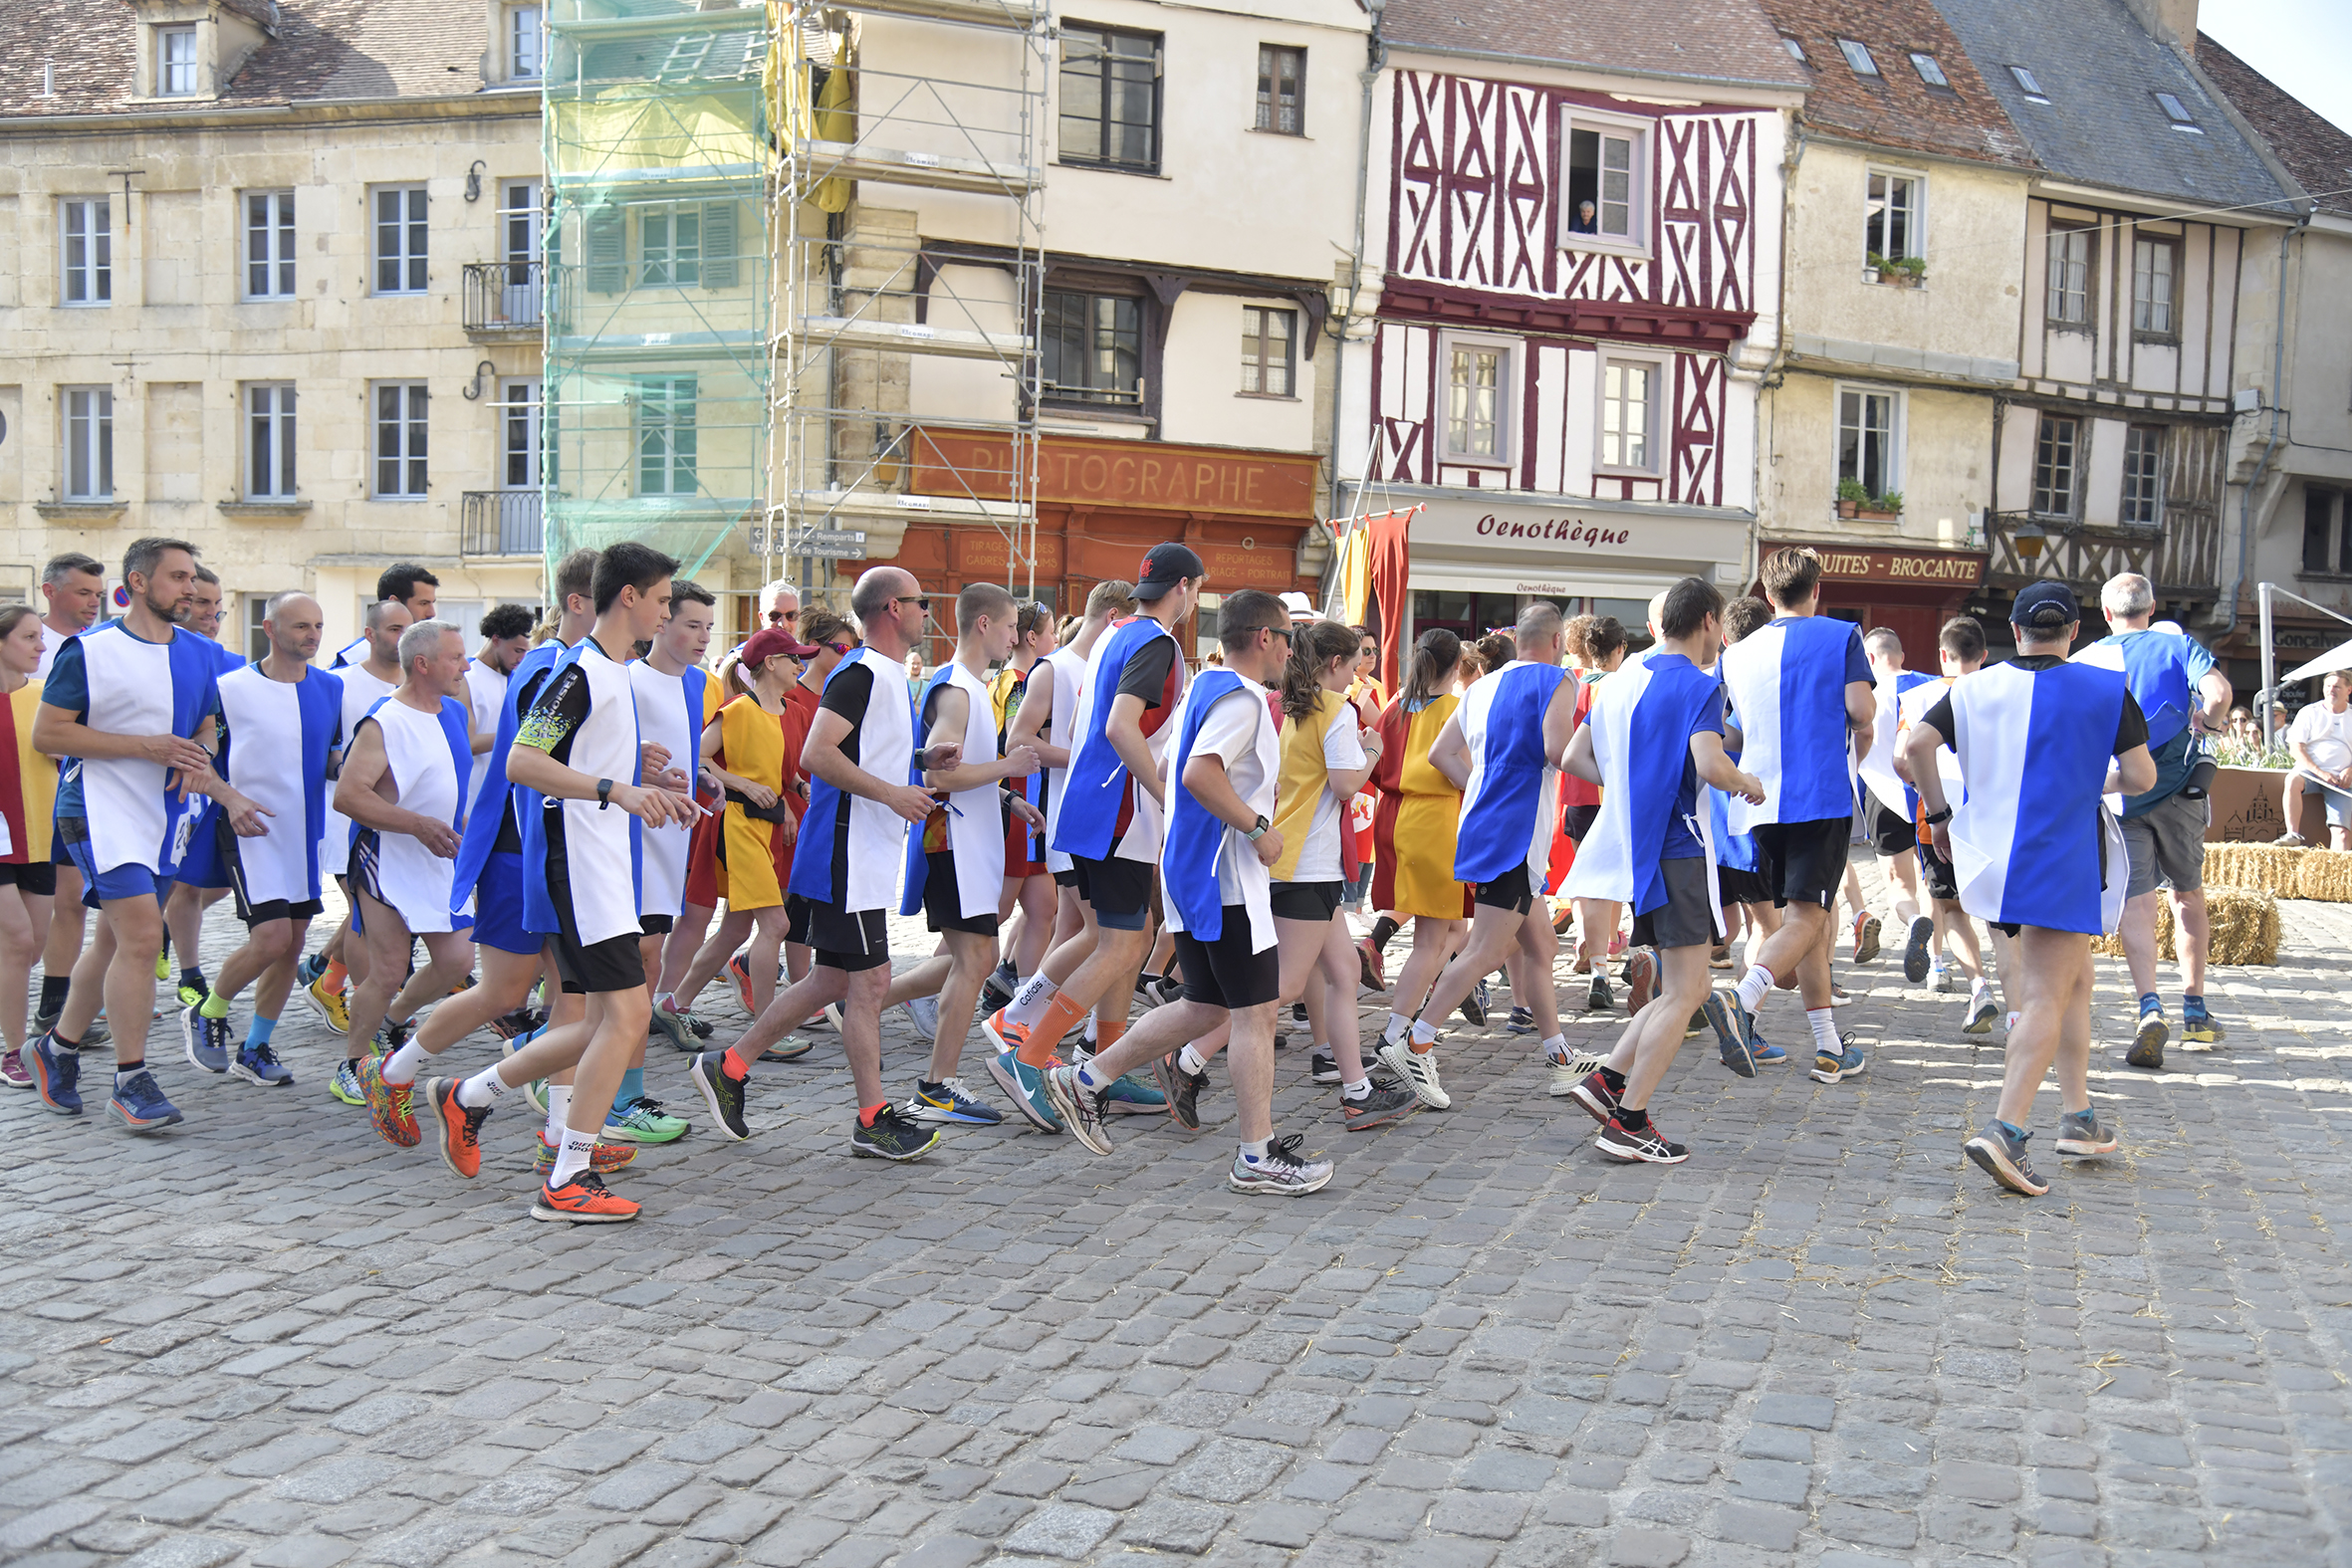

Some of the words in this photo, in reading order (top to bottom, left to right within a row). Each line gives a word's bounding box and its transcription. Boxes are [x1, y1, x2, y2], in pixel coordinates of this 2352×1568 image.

[817, 532, 855, 542] Remparts
[1477, 514, 1629, 548] Oenothèque
[802, 546, 812, 555] de
[814, 547, 848, 558] Tourisme
[970, 541, 1011, 553] TIRAGES
[966, 555, 1006, 566] CADRES
[1216, 553, 1274, 566] REPORTAGES
[1248, 568, 1292, 580] PORTRAIT
[1889, 557, 1978, 579] BROCANTE
[1517, 583, 1566, 593] Oenothèque
[1020, 981, 1044, 1007] Cofidis
